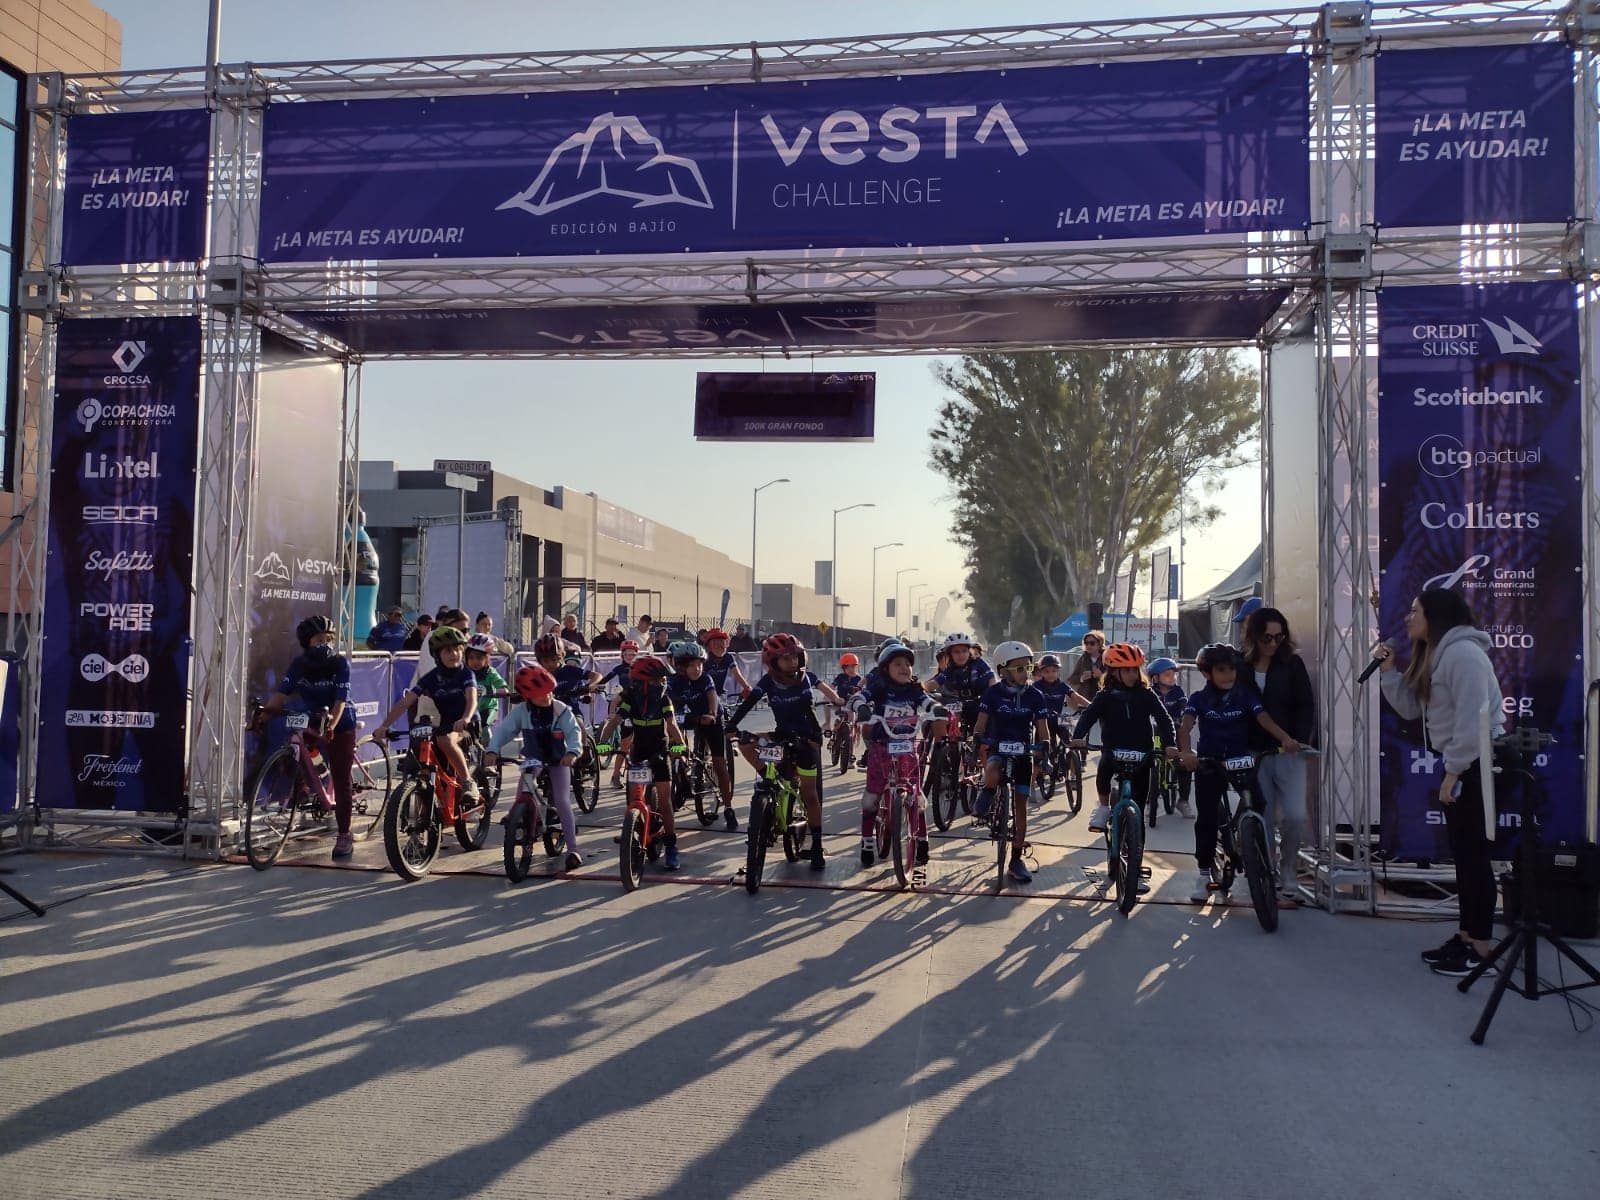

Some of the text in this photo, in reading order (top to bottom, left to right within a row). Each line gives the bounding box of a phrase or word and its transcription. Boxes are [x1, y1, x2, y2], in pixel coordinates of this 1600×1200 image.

[1412, 109, 1527, 137] ¡LA META
[1399, 137, 1550, 162] ES AYUDAR!
[91, 165, 174, 189] ¡LA META
[80, 189, 190, 210] ES AYUDAR!
[771, 177, 943, 209] CHALLENGE
[1056, 197, 1285, 229] ¡LA META ES AYUDAR!
[550, 218, 677, 236] EDICIÓN BAJÍO
[273, 226, 465, 251] ¡LA META ES AYUDAR!
[1412, 323, 1480, 340] CREDIT
[1422, 341, 1480, 357] SUISSE
[103, 375, 151, 385] CROCSA
[1413, 386, 1545, 407] Scotiabank
[102, 404, 177, 418] COPACHISA
[767, 422, 793, 431] GRAN
[793, 422, 825, 431] FONDO
[84, 451, 159, 479] Lintel
[1431, 446, 1541, 470] btg pactual
[1420, 501, 1541, 530] Colliers
[84, 550, 155, 583] Safetti
[1493, 567, 1536, 580] Grand
[273, 588, 291, 599] META
[291, 589, 301, 600] ES
[1461, 580, 1536, 590] Fiesta Americana
[80, 602, 155, 618] POWER
[109, 616, 153, 632] ADE
[1483, 624, 1524, 634] GRUPO
[82, 658, 146, 676] ciel ciel
[77, 753, 144, 782] Freixenet
